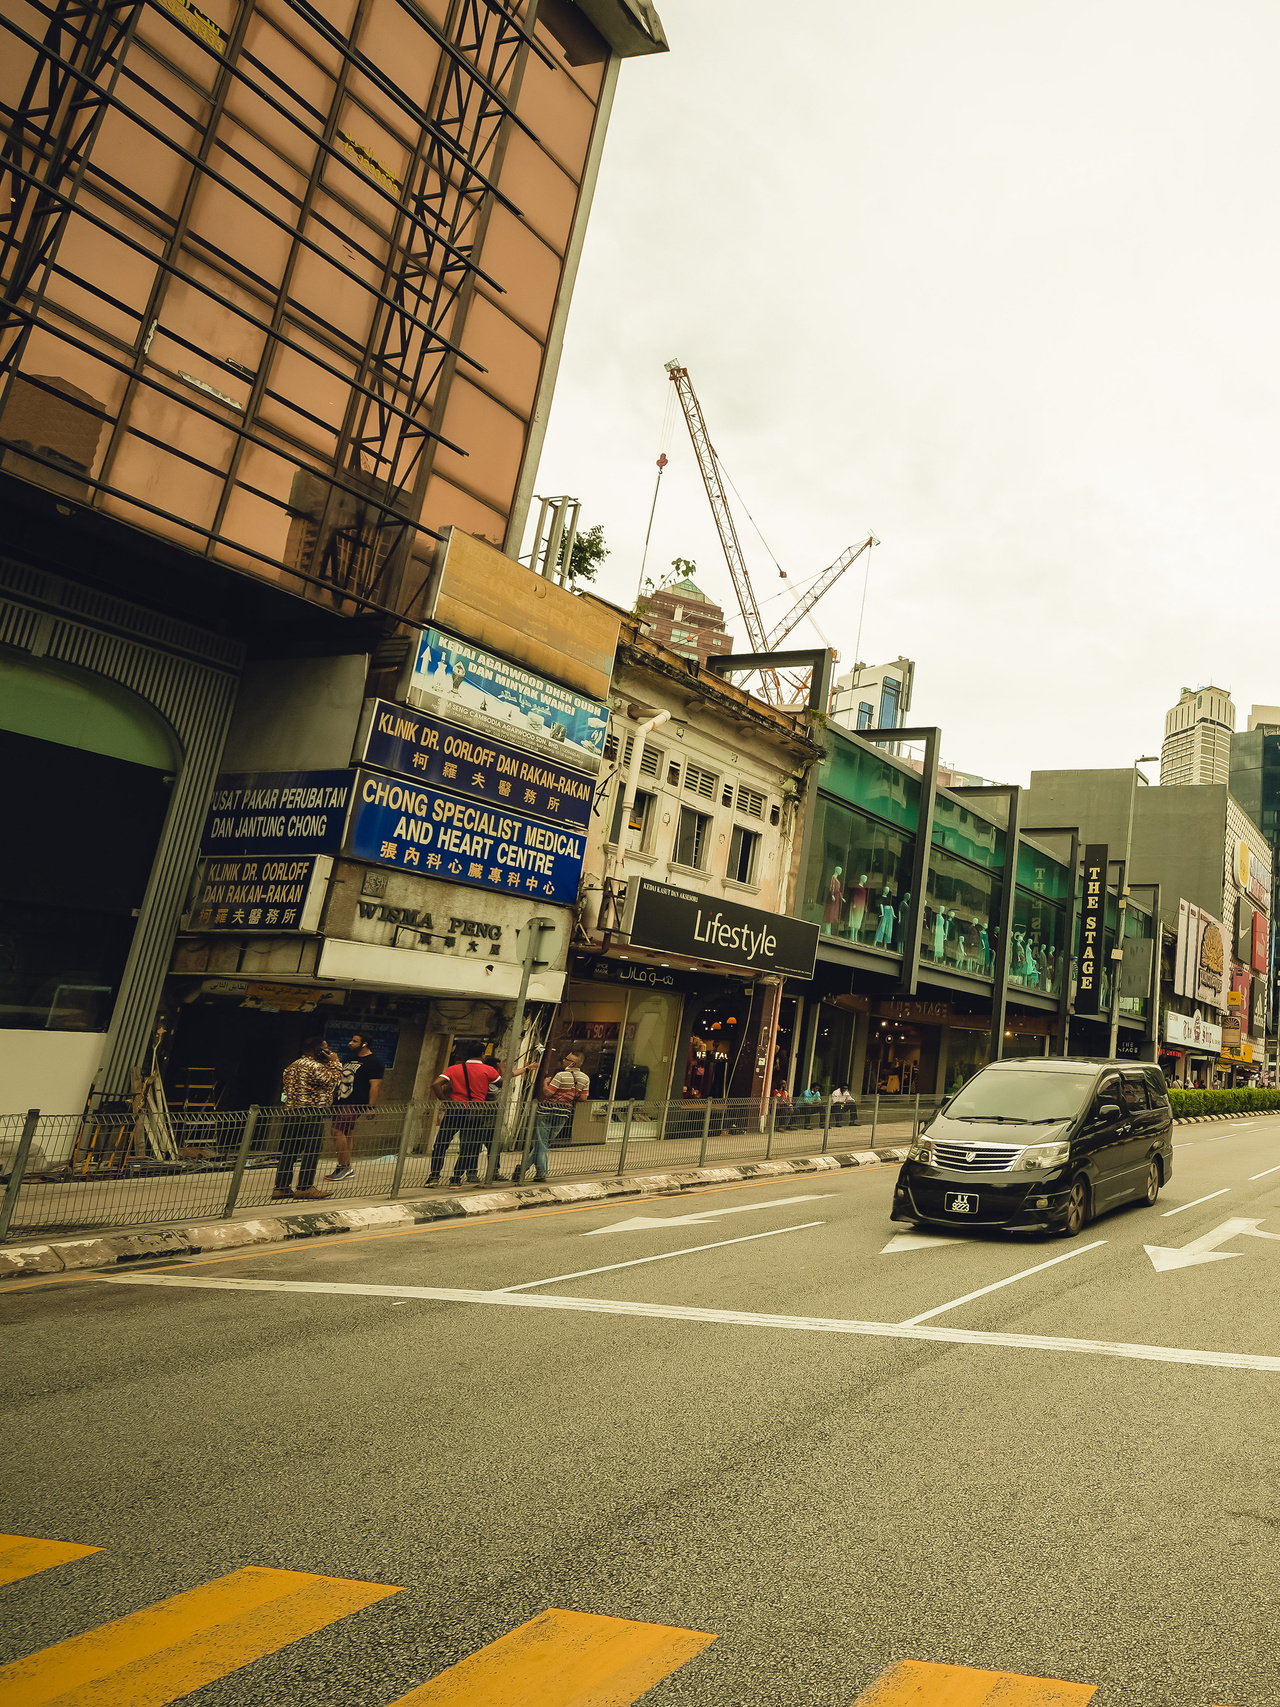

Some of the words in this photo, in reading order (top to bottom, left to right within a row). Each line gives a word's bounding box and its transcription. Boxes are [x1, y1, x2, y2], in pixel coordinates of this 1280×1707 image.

[438, 636, 476, 660] KEDAI
[477, 651, 544, 690] AGARWOOD
[545, 681, 573, 703] DHEN
[574, 697, 602, 717] OUDH
[467, 662, 494, 681] DAN
[495, 672, 538, 701] MINYAK
[540, 691, 576, 717] WANGI
[378, 712, 420, 744] KLINIK
[420, 726, 440, 751] DR.
[444, 736, 496, 769] OORLOFF
[496, 754, 520, 777] DAN
[502, 722, 535, 741] AGARWOOD
[241, 788, 280, 810] PAKAR
[279, 787, 348, 809] PERUBATAN
[362, 779, 428, 818] CHONG
[431, 798, 522, 842] SPECIALIST
[524, 825, 581, 860] MEDICAL
[210, 817, 235, 839] DAN
[235, 816, 286, 838] JANTUNG
[287, 815, 328, 838] CHONG
[393, 816, 434, 845] AND
[437, 826, 494, 860] HEART
[496, 842, 555, 876] CENTRE
[203, 885, 226, 903] DAN
[208, 863, 241, 882] KLINIK
[242, 862, 258, 882] DR.
[262, 862, 310, 881] OORLOFF
[1087, 867, 1100, 909] THE
[357, 900, 434, 930] WISMA
[448, 917, 503, 941] PENG
[694, 909, 777, 960] Lifestyle
[1081, 916, 1097, 990] STAGE
